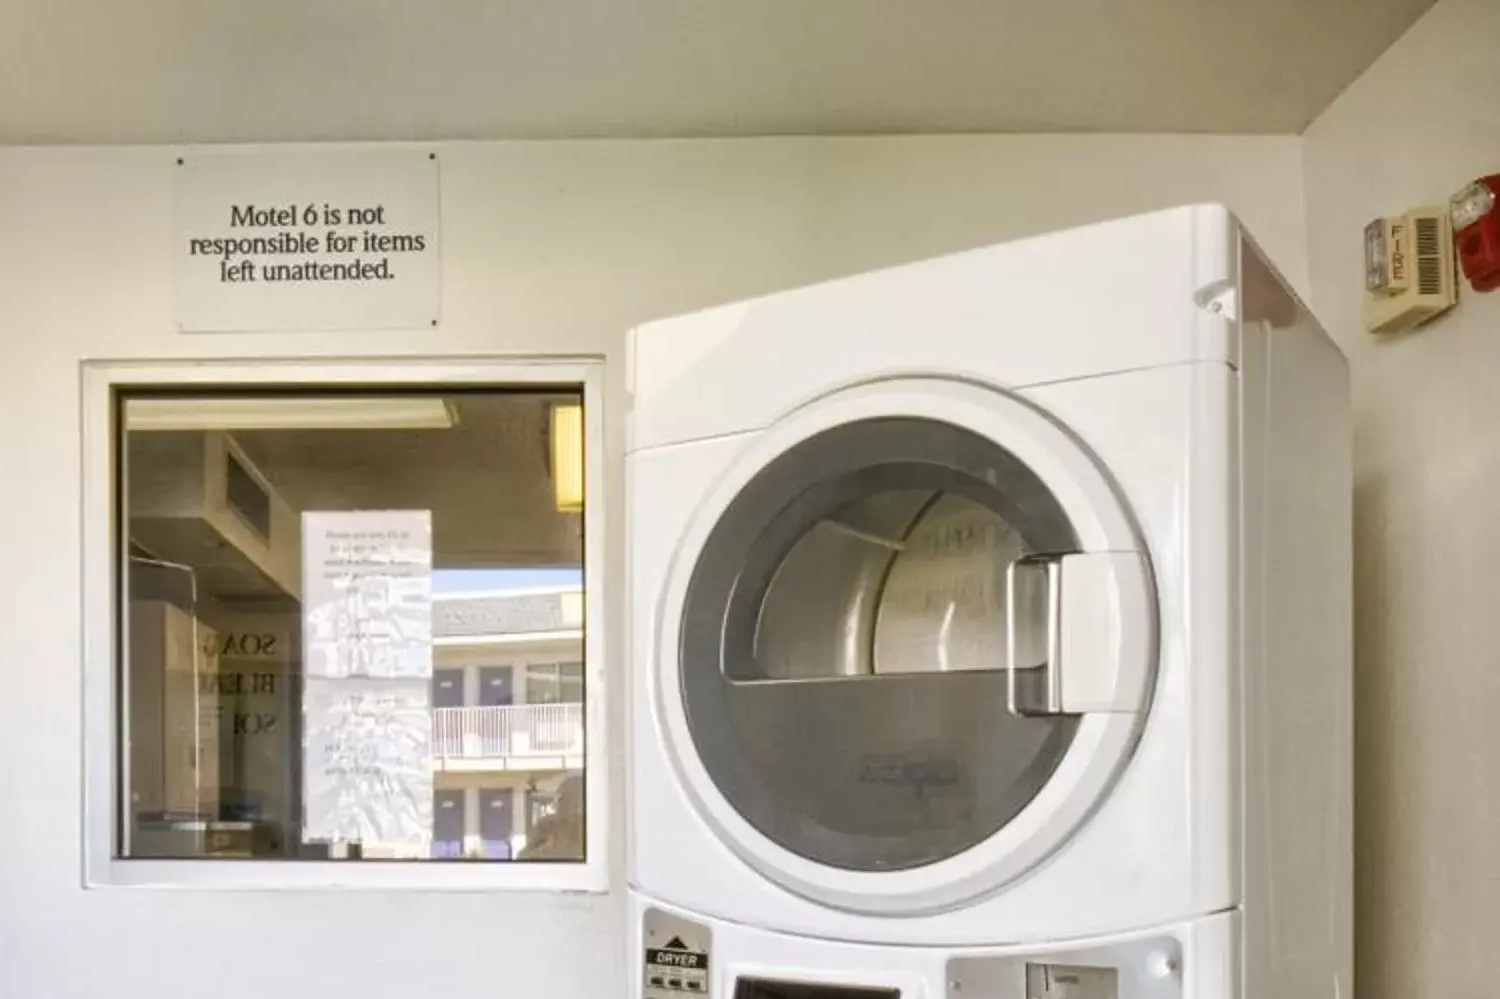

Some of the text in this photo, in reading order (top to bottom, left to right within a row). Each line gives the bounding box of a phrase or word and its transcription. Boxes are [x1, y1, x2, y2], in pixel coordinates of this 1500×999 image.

[230, 204, 385, 227] Motel 6 is not
[190, 231, 426, 260] responsible for items
[1391, 224, 1405, 280] FIRE
[220, 259, 395, 282] left unattended.
[656, 951, 698, 967] DRYER
